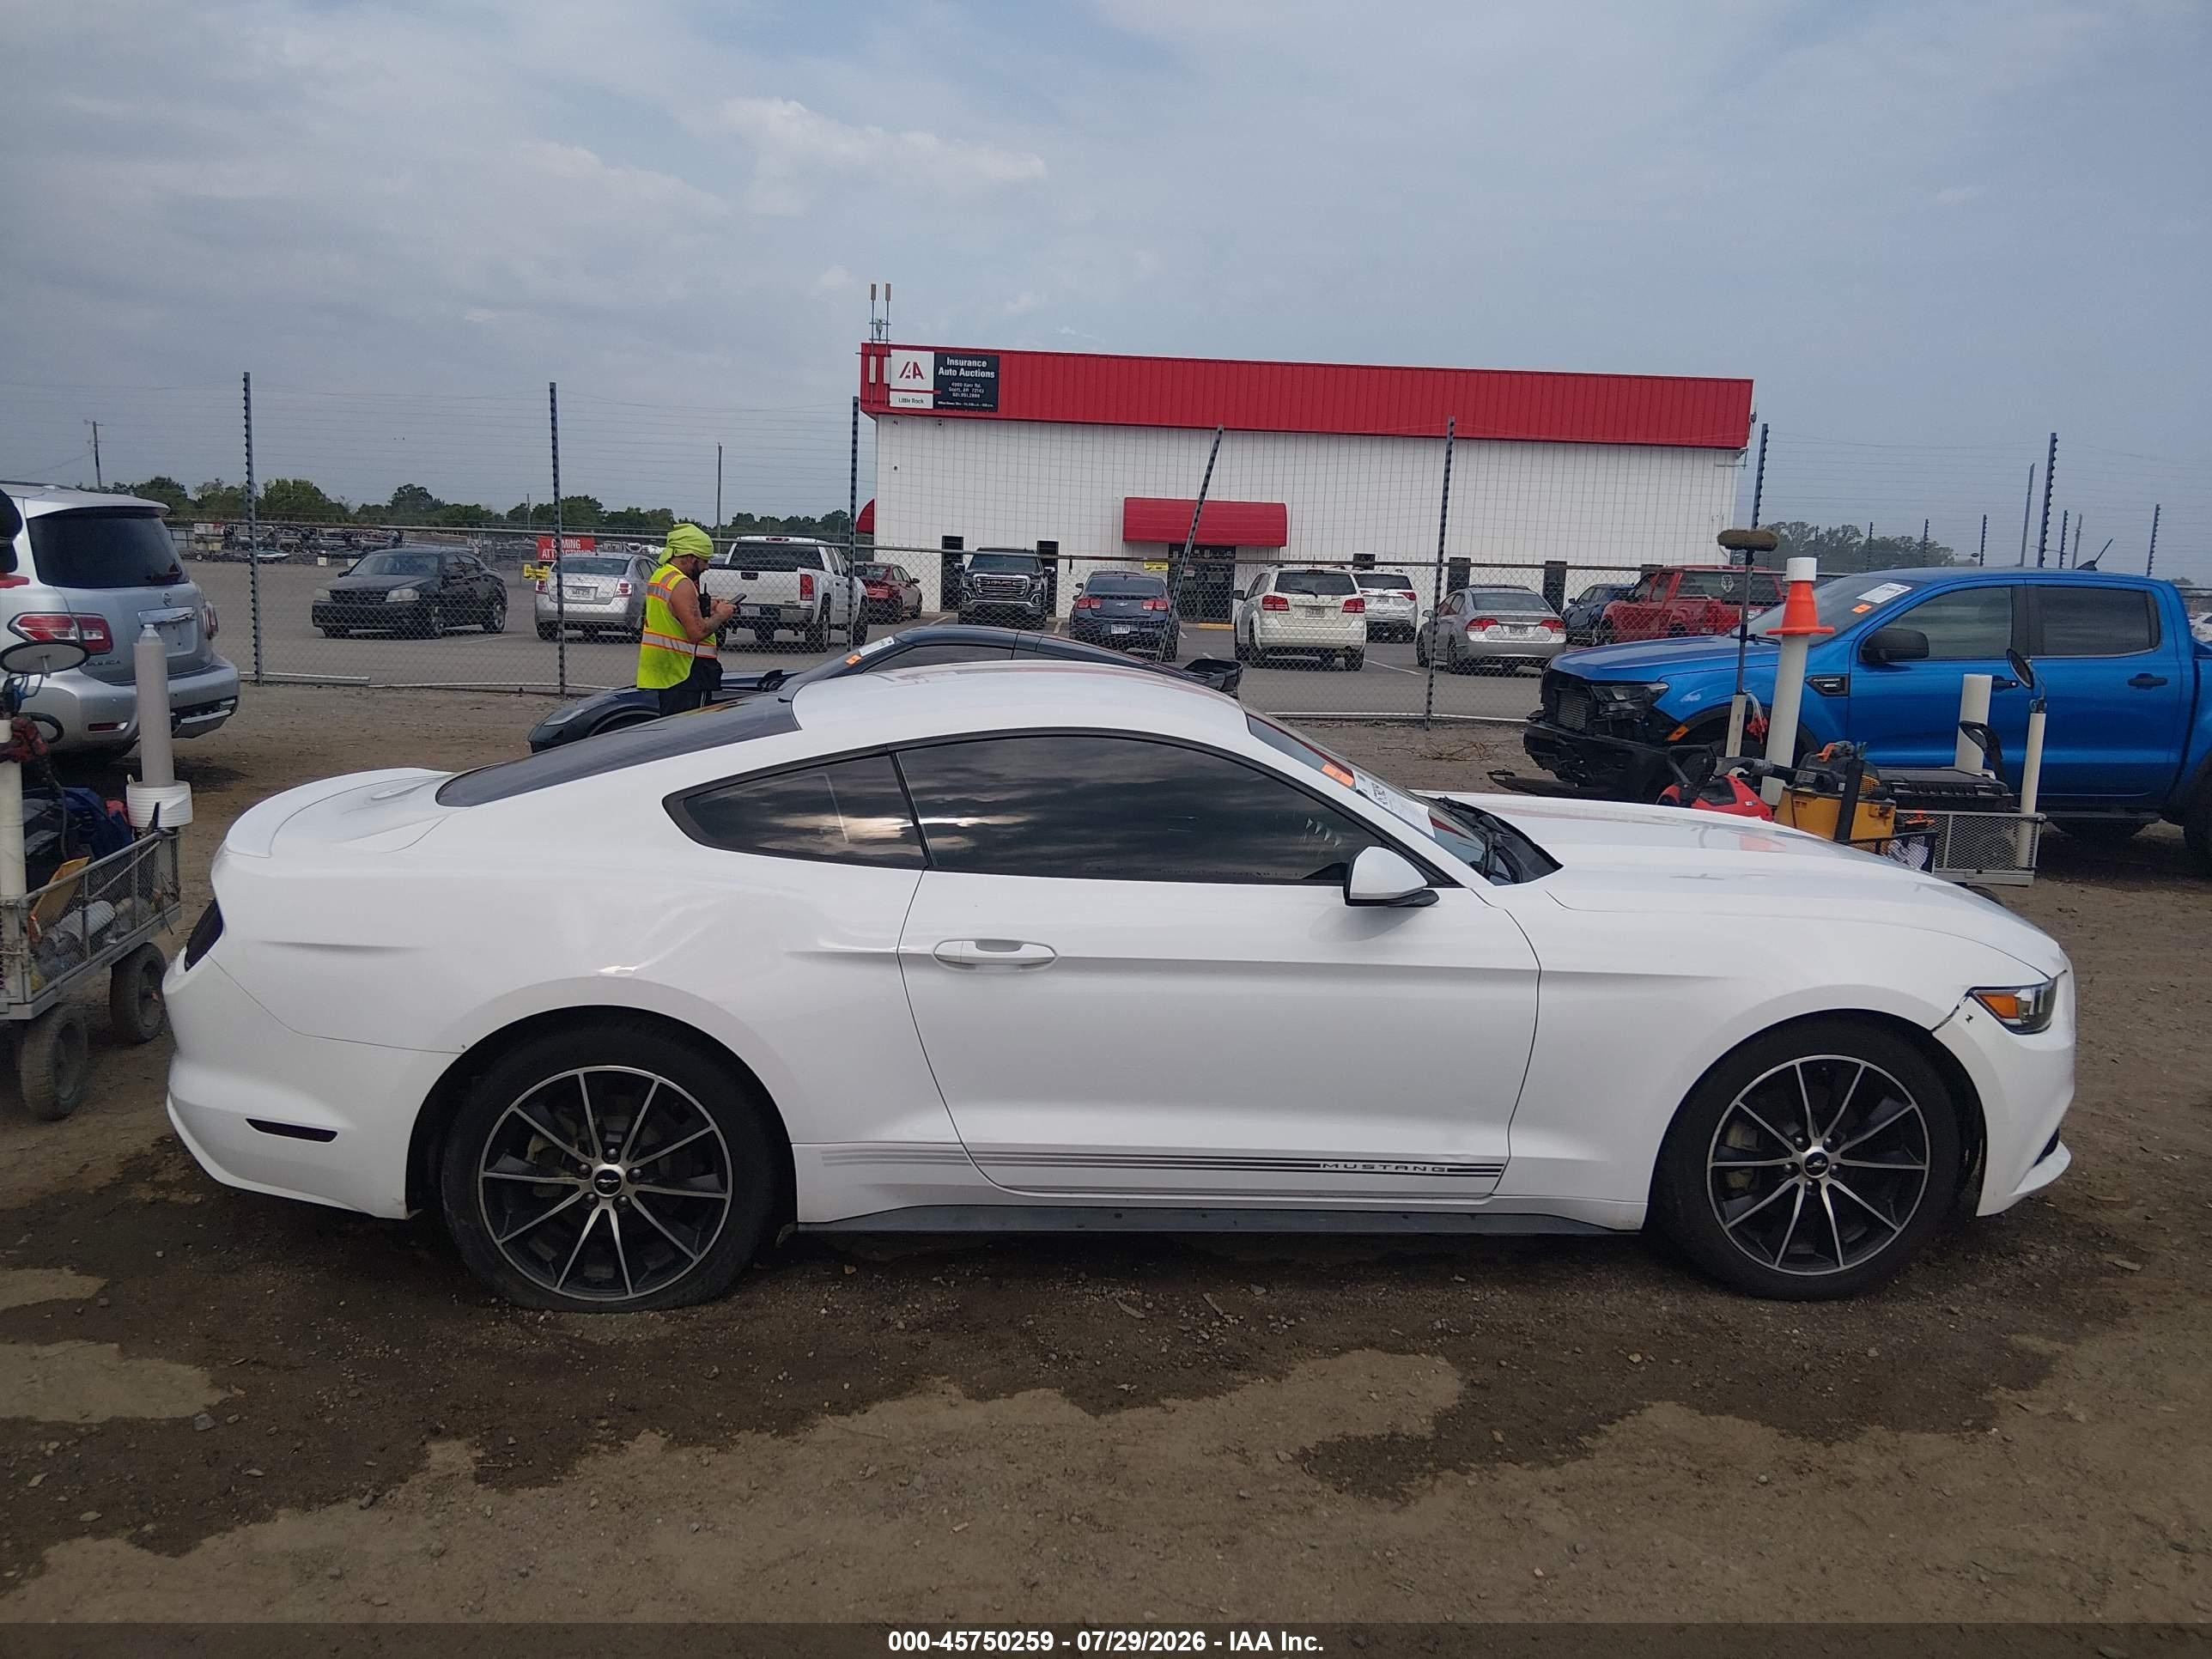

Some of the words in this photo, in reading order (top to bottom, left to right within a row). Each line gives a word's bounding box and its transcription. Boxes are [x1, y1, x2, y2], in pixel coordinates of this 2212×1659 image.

[946, 356, 988, 368] Insurance
[938, 367, 957, 376] Auto
[959, 368, 995, 379] Auctions
[550, 538, 581, 550] CMING
[1322, 1163, 1448, 1173] MUSTANG
